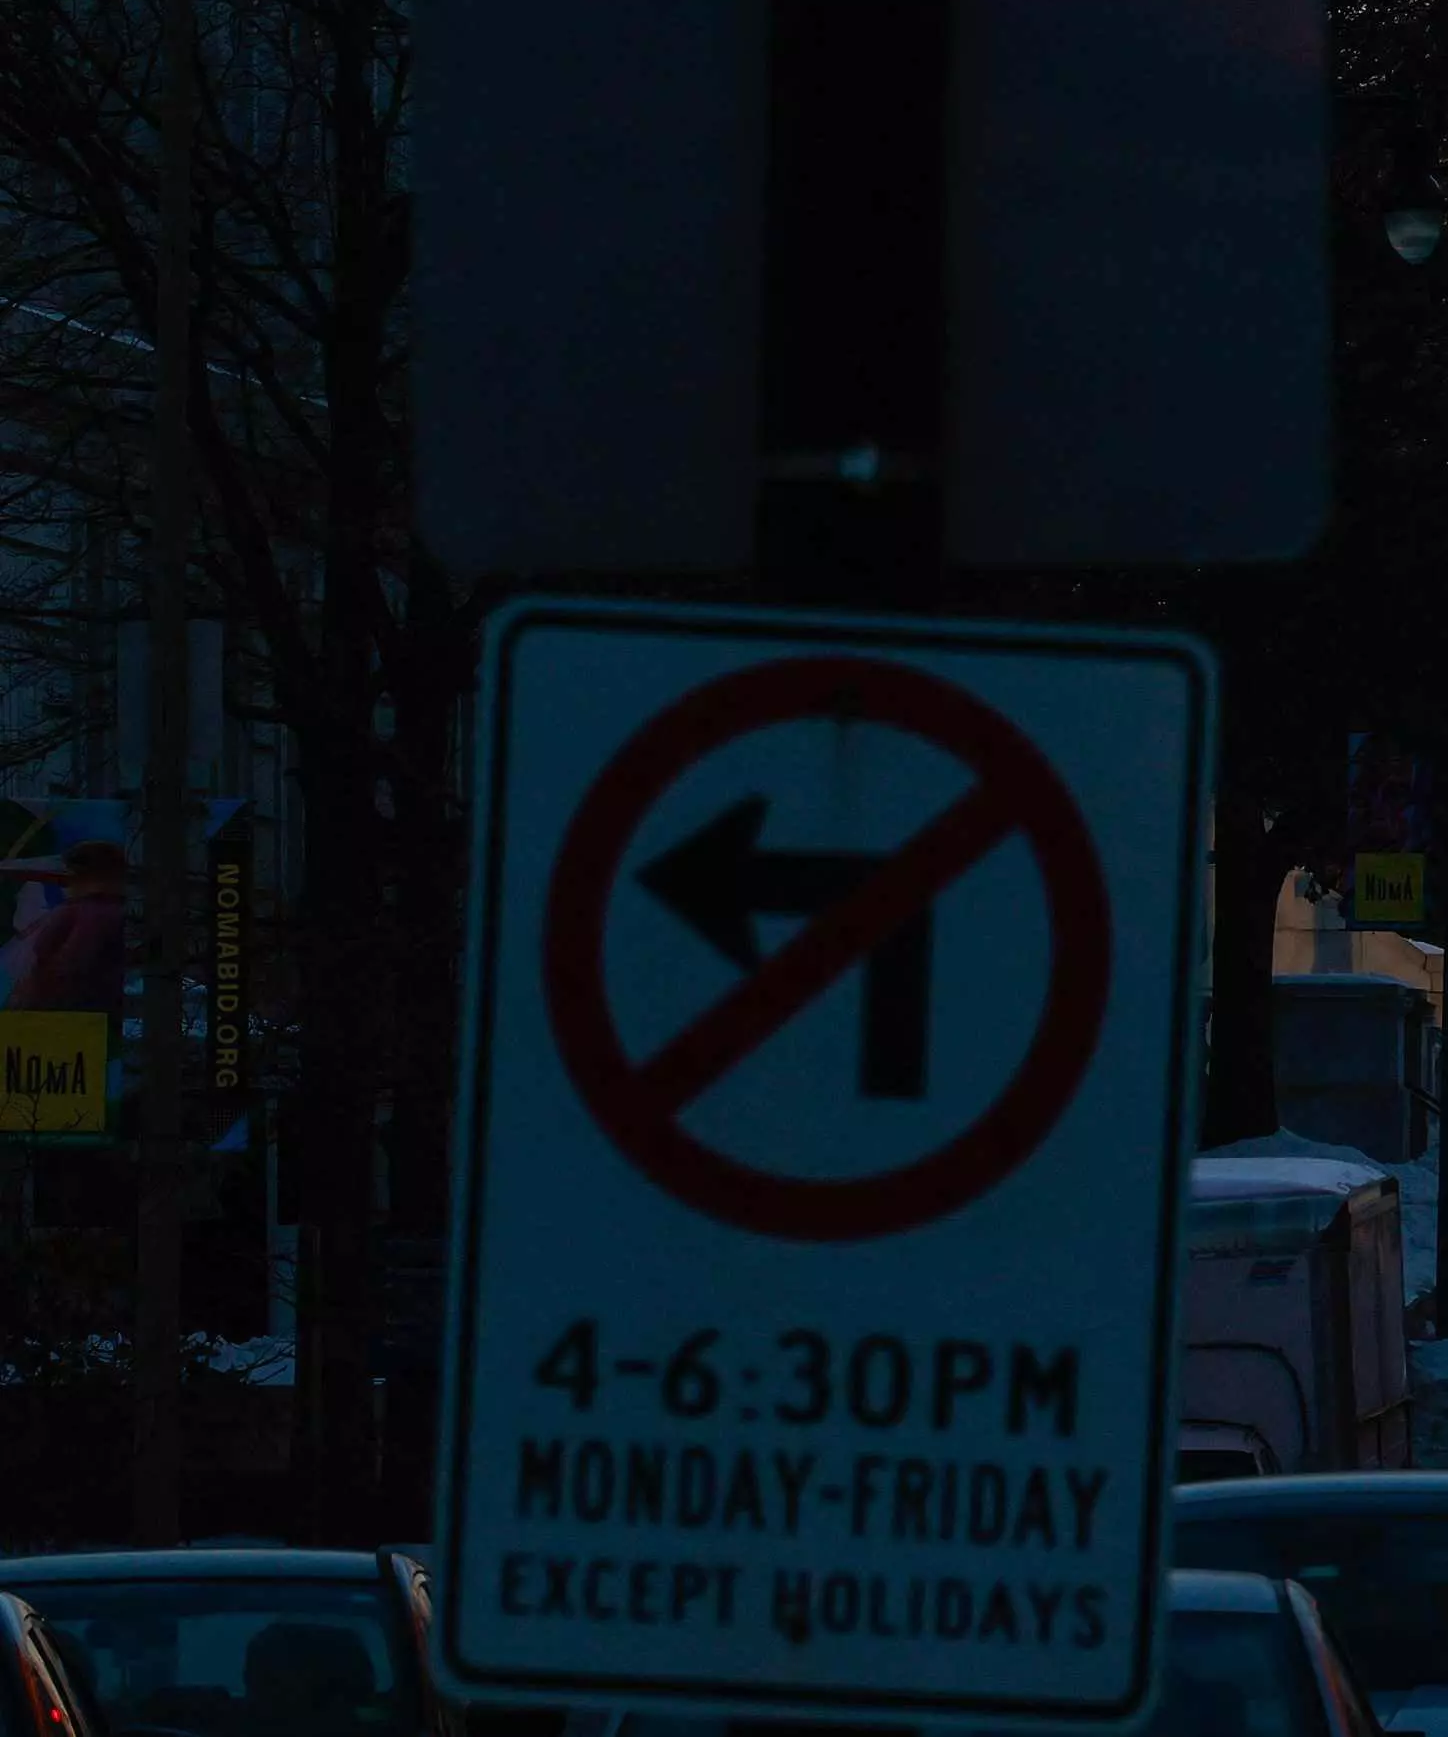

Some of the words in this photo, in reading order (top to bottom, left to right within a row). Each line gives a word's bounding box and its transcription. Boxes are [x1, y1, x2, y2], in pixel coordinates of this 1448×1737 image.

[217, 863, 240, 1088] NOMABID.ORG
[536, 1319, 1079, 1437] 4-6:30PM
[517, 1437, 1108, 1552] MONDAY-FRIDAY
[501, 1551, 740, 1629] EXCEPT
[771, 1568, 1108, 1648] HOLIDAYS
